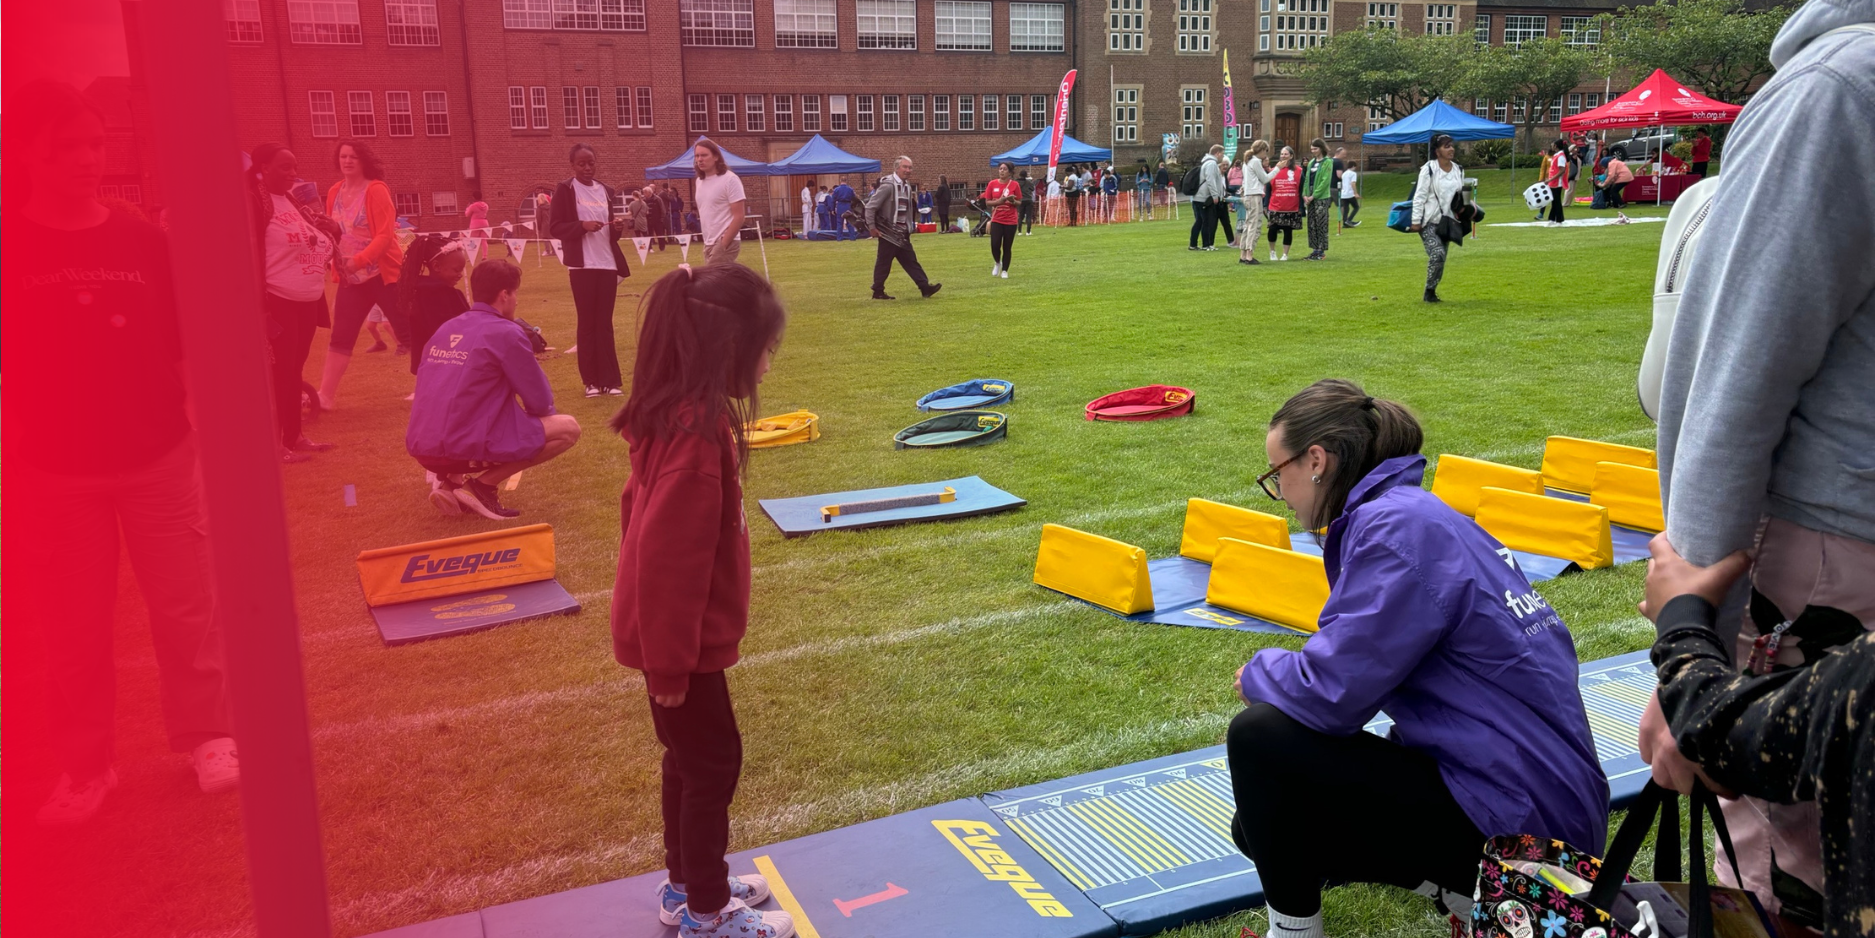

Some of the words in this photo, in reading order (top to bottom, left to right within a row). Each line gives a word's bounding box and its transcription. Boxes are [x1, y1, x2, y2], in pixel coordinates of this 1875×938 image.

[21, 271, 63, 291] Dear
[429, 345, 469, 360] funetics
[400, 548, 521, 584] Eveque
[1504, 589, 1546, 619] fune
[1525, 622, 1542, 637] run
[931, 820, 1074, 918] Eveque
[832, 882, 909, 918] 1
